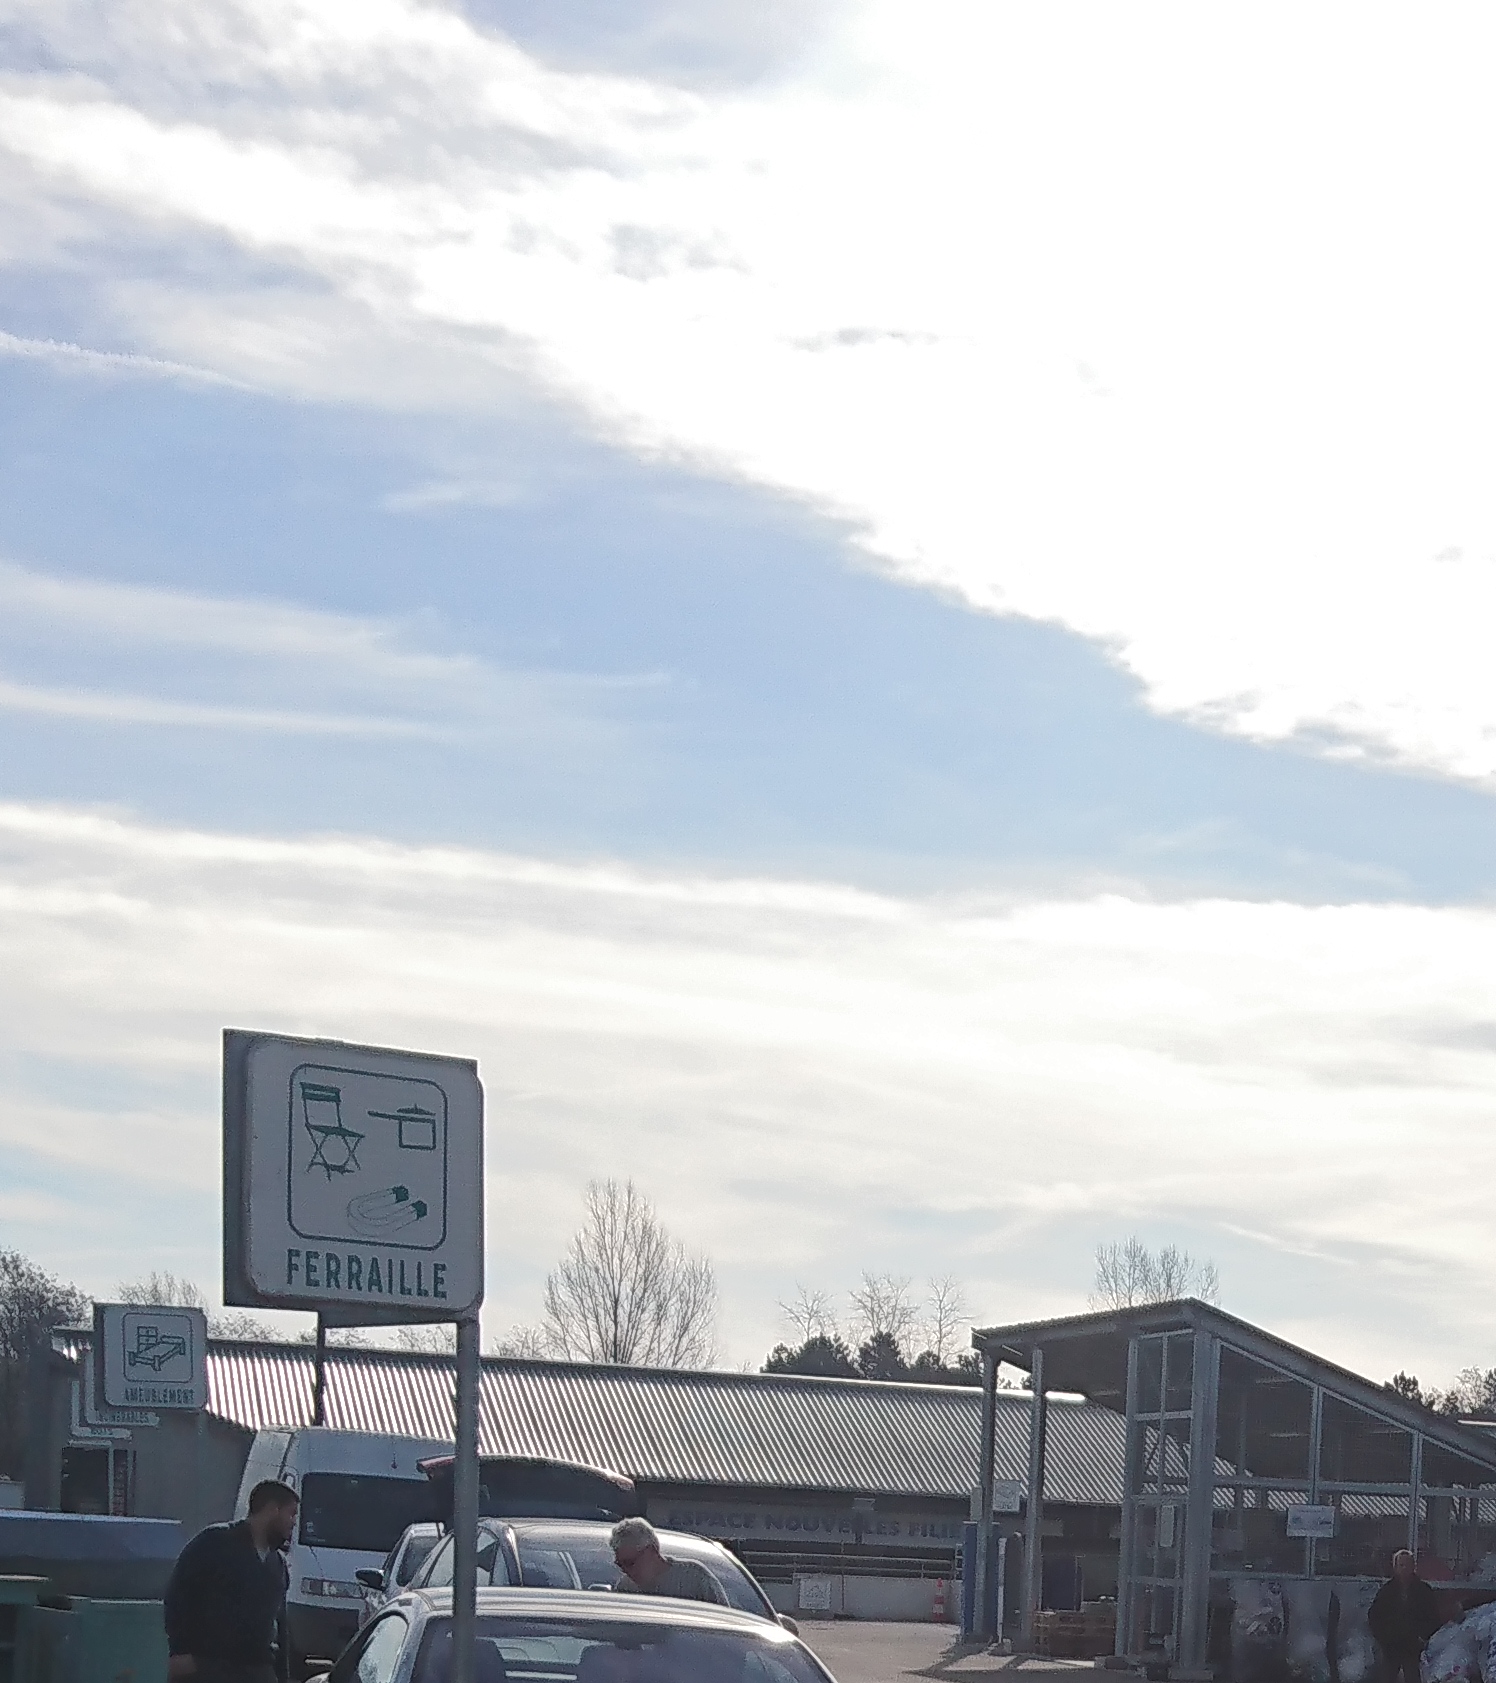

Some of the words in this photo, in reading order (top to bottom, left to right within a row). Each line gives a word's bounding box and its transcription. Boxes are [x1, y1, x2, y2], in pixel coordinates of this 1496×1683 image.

[287, 1248, 448, 1299] FERRAILLE
[124, 1386, 195, 1404] AMEUBLEMENT
[668, 1510, 755, 1529] ESPACE
[765, 1513, 900, 1537] NOUVELES
